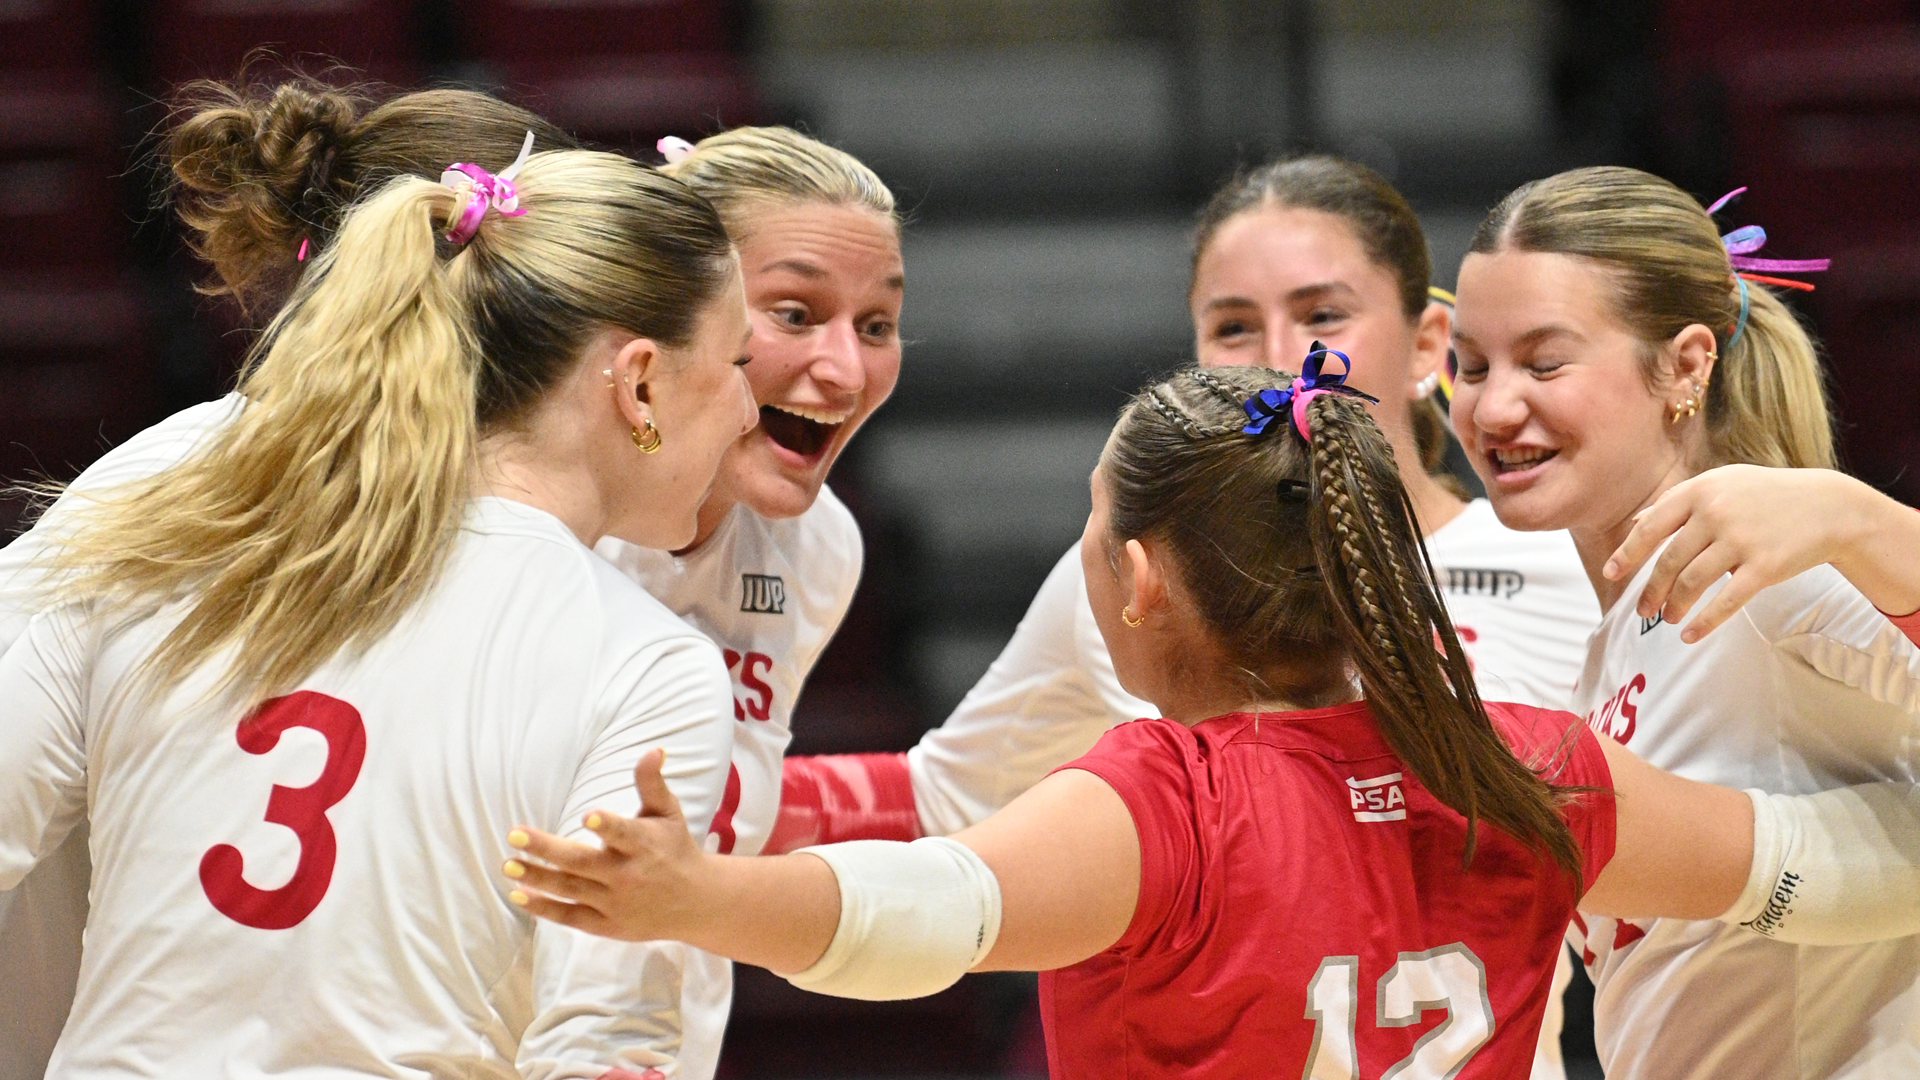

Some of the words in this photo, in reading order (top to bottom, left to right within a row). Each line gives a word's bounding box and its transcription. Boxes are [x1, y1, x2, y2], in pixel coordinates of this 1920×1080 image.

[740, 573, 786, 614] IUP
[198, 689, 367, 931] 3
[1349, 784, 1406, 810] PSA
[1301, 941, 1495, 1080] 12
